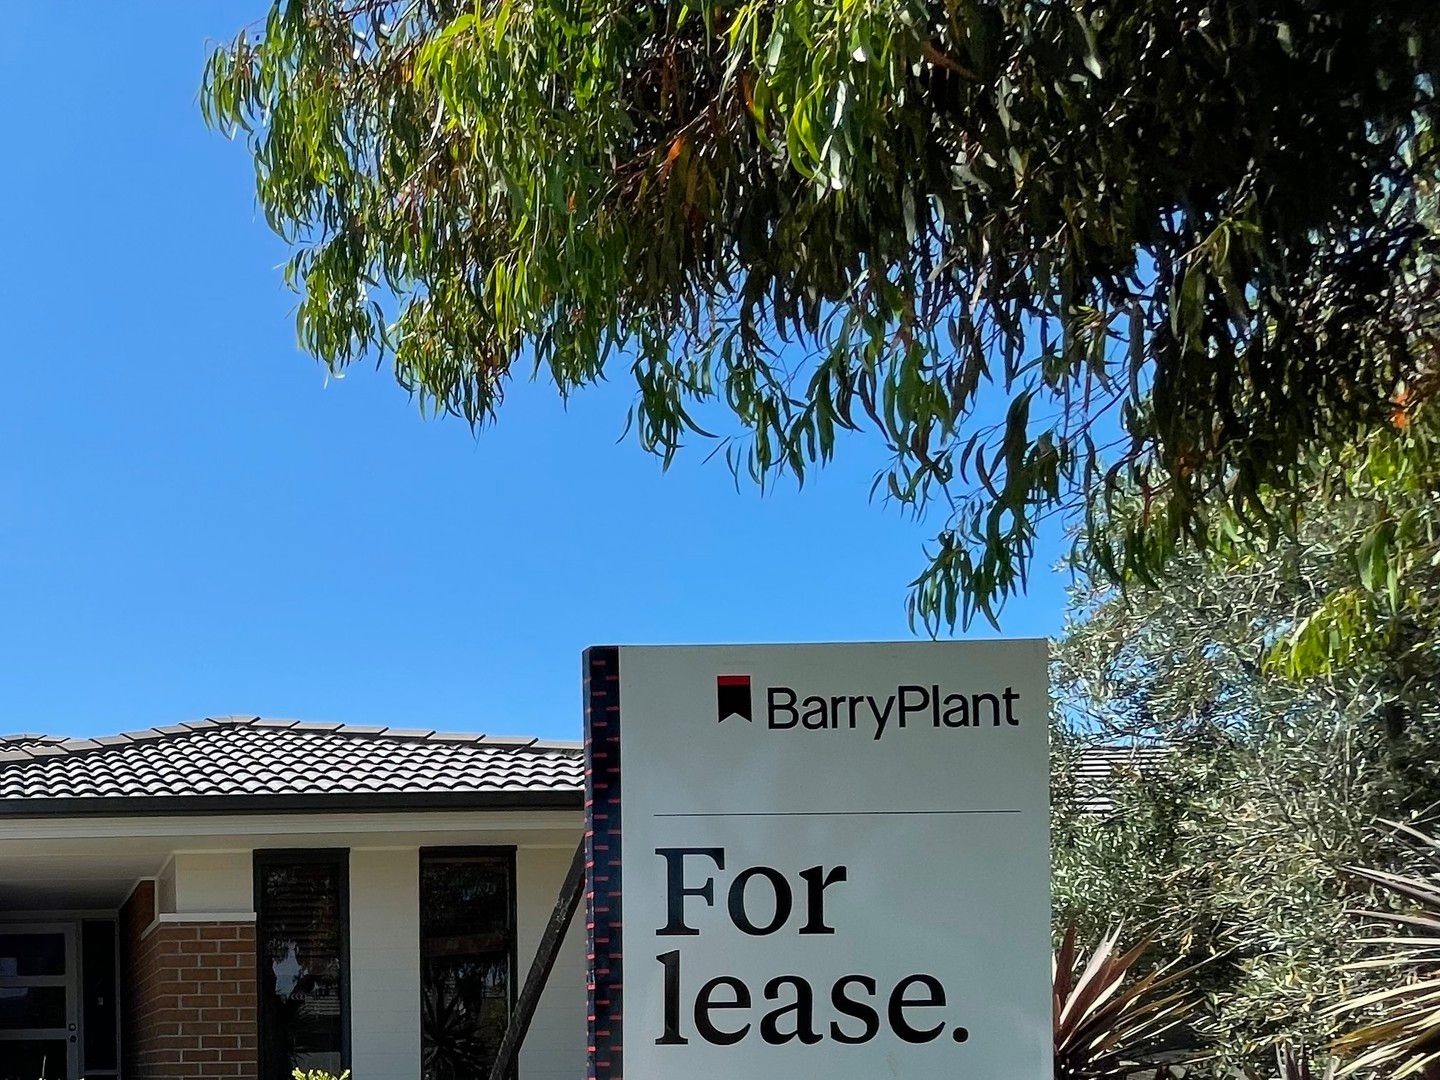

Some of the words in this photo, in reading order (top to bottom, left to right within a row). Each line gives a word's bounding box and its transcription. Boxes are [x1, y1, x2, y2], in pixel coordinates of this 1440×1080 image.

[767, 684, 1021, 741] BarryPlant
[654, 847, 848, 936] For
[654, 949, 970, 1046] lease.
